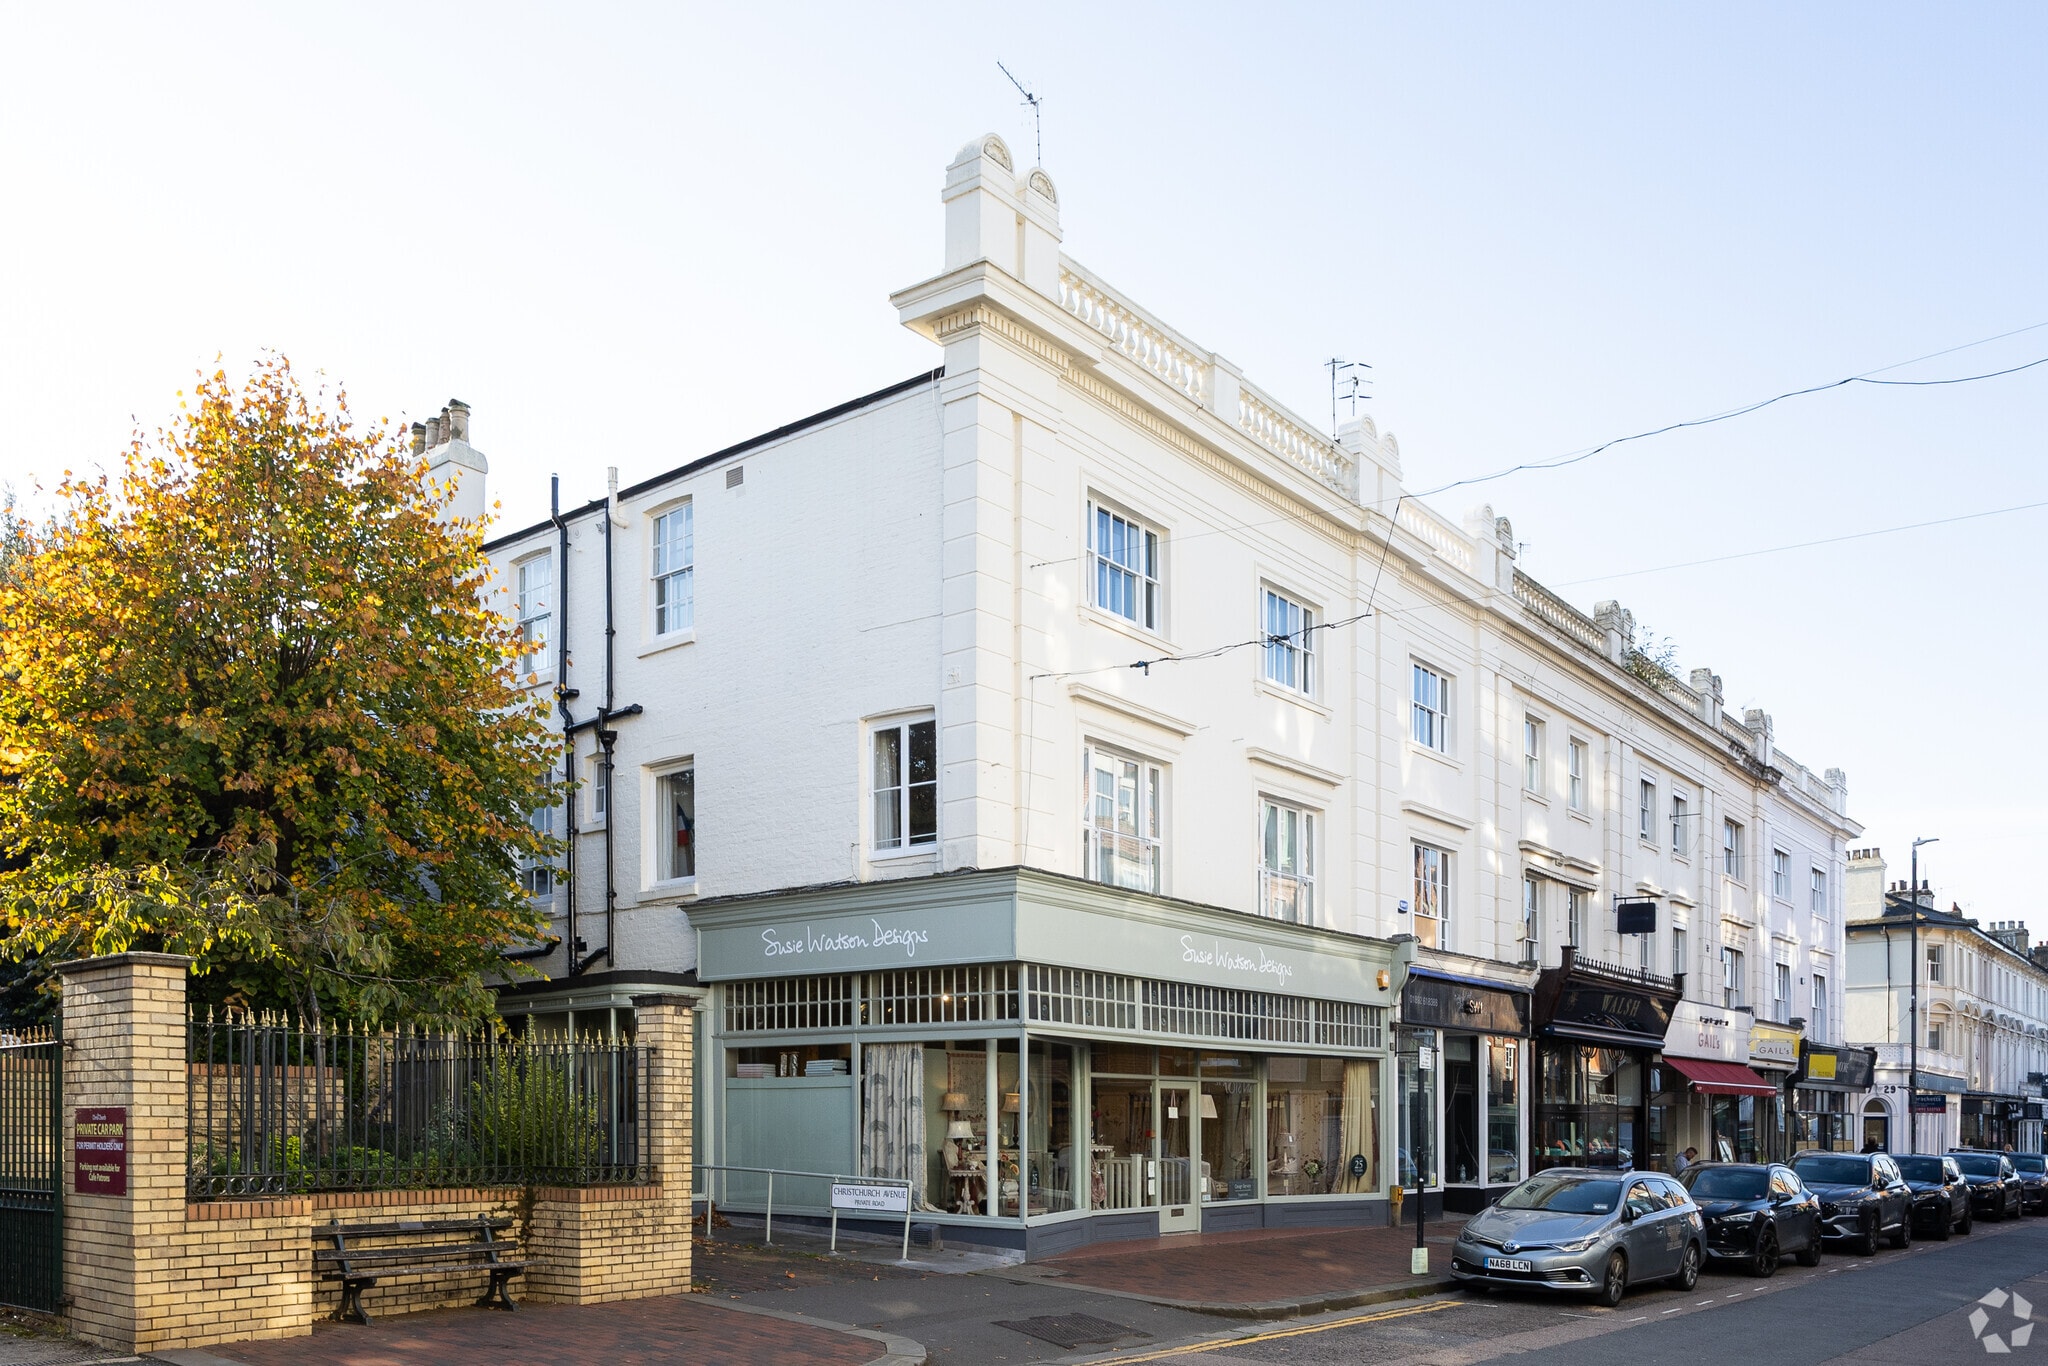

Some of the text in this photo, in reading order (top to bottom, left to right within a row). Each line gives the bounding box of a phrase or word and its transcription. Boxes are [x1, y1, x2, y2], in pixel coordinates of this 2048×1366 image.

[761, 918, 929, 957] Susie Watson Designs
[1180, 934, 1293, 987] Susie Watson Designs
[1600, 994, 1641, 1017] WALSH
[1698, 1033, 1720, 1049] GAIL's
[1759, 1046, 1790, 1055] GAIL's
[1884, 1085, 1896, 1094] 29
[76, 1123, 124, 1136] PRIVATE CAR PARK
[97, 1142, 113, 1150] HOLDERS
[114, 1142, 123, 1151] ONLY
[79, 1162, 92, 1172] Parking
[99, 1163, 114, 1172] available
[1354, 1160, 1363, 1169] 25
[833, 1187, 906, 1199] CHRISTCHURCH AVENUE
[1397, 1187, 1403, 1201] H
[1489, 1259, 1529, 1270] NA68 LCN
